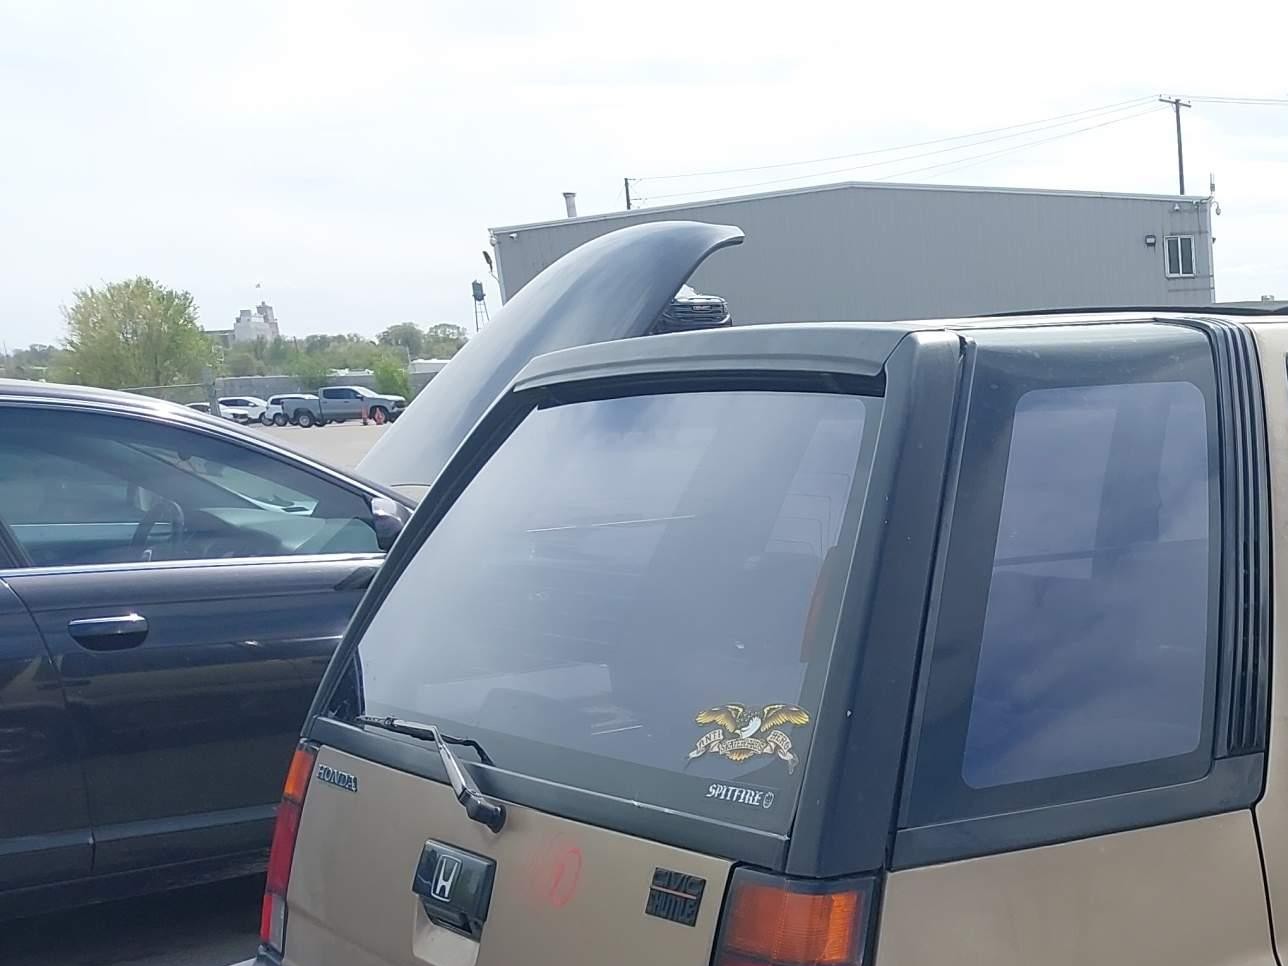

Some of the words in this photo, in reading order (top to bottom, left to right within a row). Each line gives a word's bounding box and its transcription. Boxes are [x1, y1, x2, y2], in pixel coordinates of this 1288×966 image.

[697, 730, 723, 753] ANTI
[317, 763, 358, 793] HONDA
[706, 783, 763, 806] SPITFIRE
[653, 867, 704, 897] CIVIC
